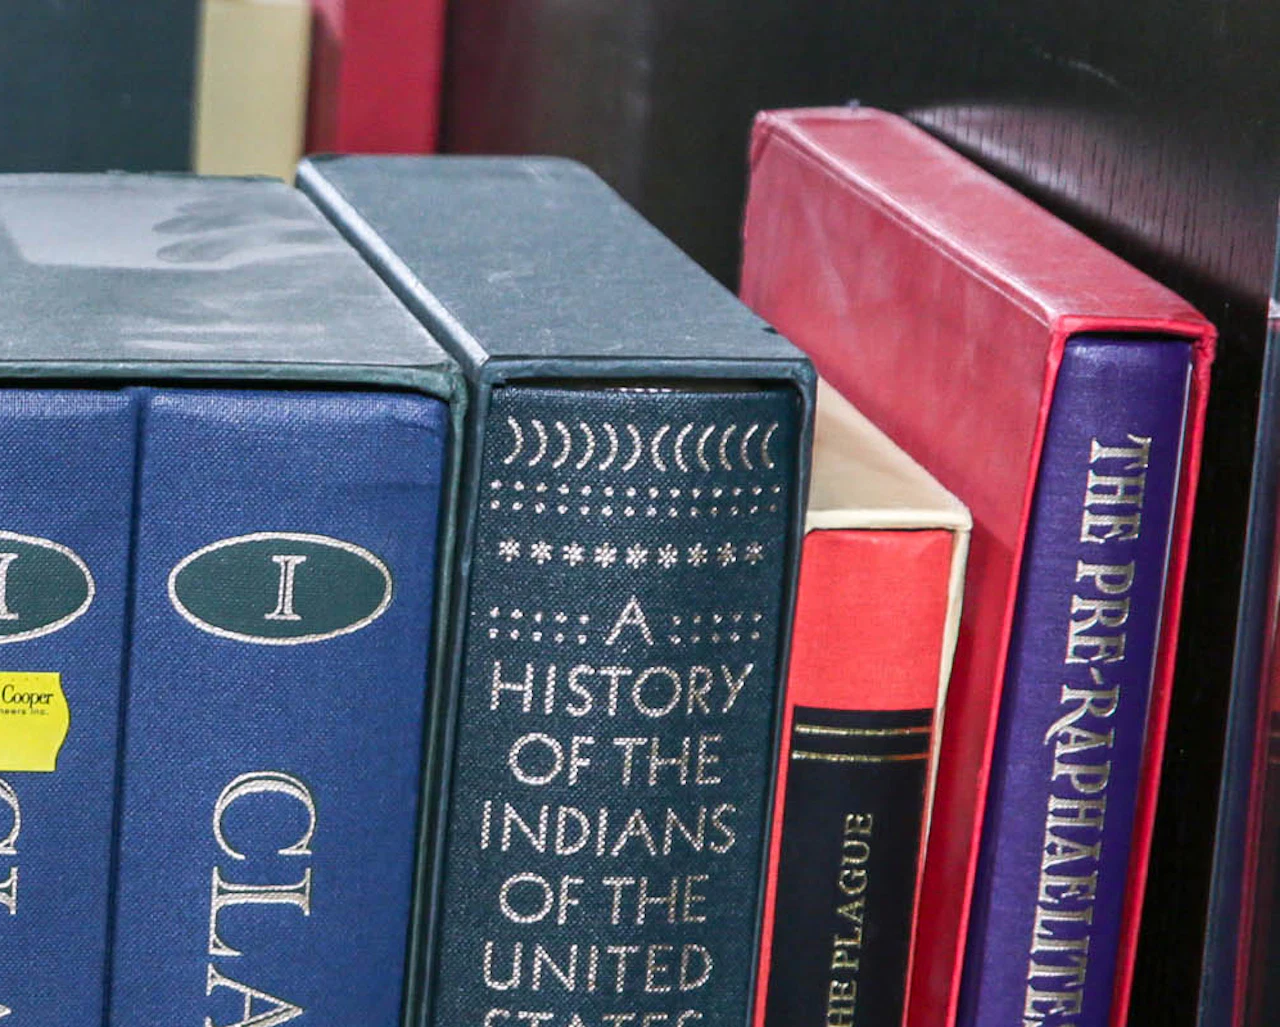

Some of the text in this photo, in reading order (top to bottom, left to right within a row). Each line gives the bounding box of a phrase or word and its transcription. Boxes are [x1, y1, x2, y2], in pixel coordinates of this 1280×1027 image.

[1080, 434, 1152, 544] THE
[264, 554, 307, 621] I
[605, 594, 654, 647] A
[2, 684, 53, 708] Cooper
[489, 661, 754, 718] HISTORY
[508, 732, 723, 787] OF THE
[480, 799, 737, 858] INDIANS
[498, 871, 710, 925] OF THE
[832, 811, 874, 972] PLAGUE
[483, 940, 713, 993] UNITED
